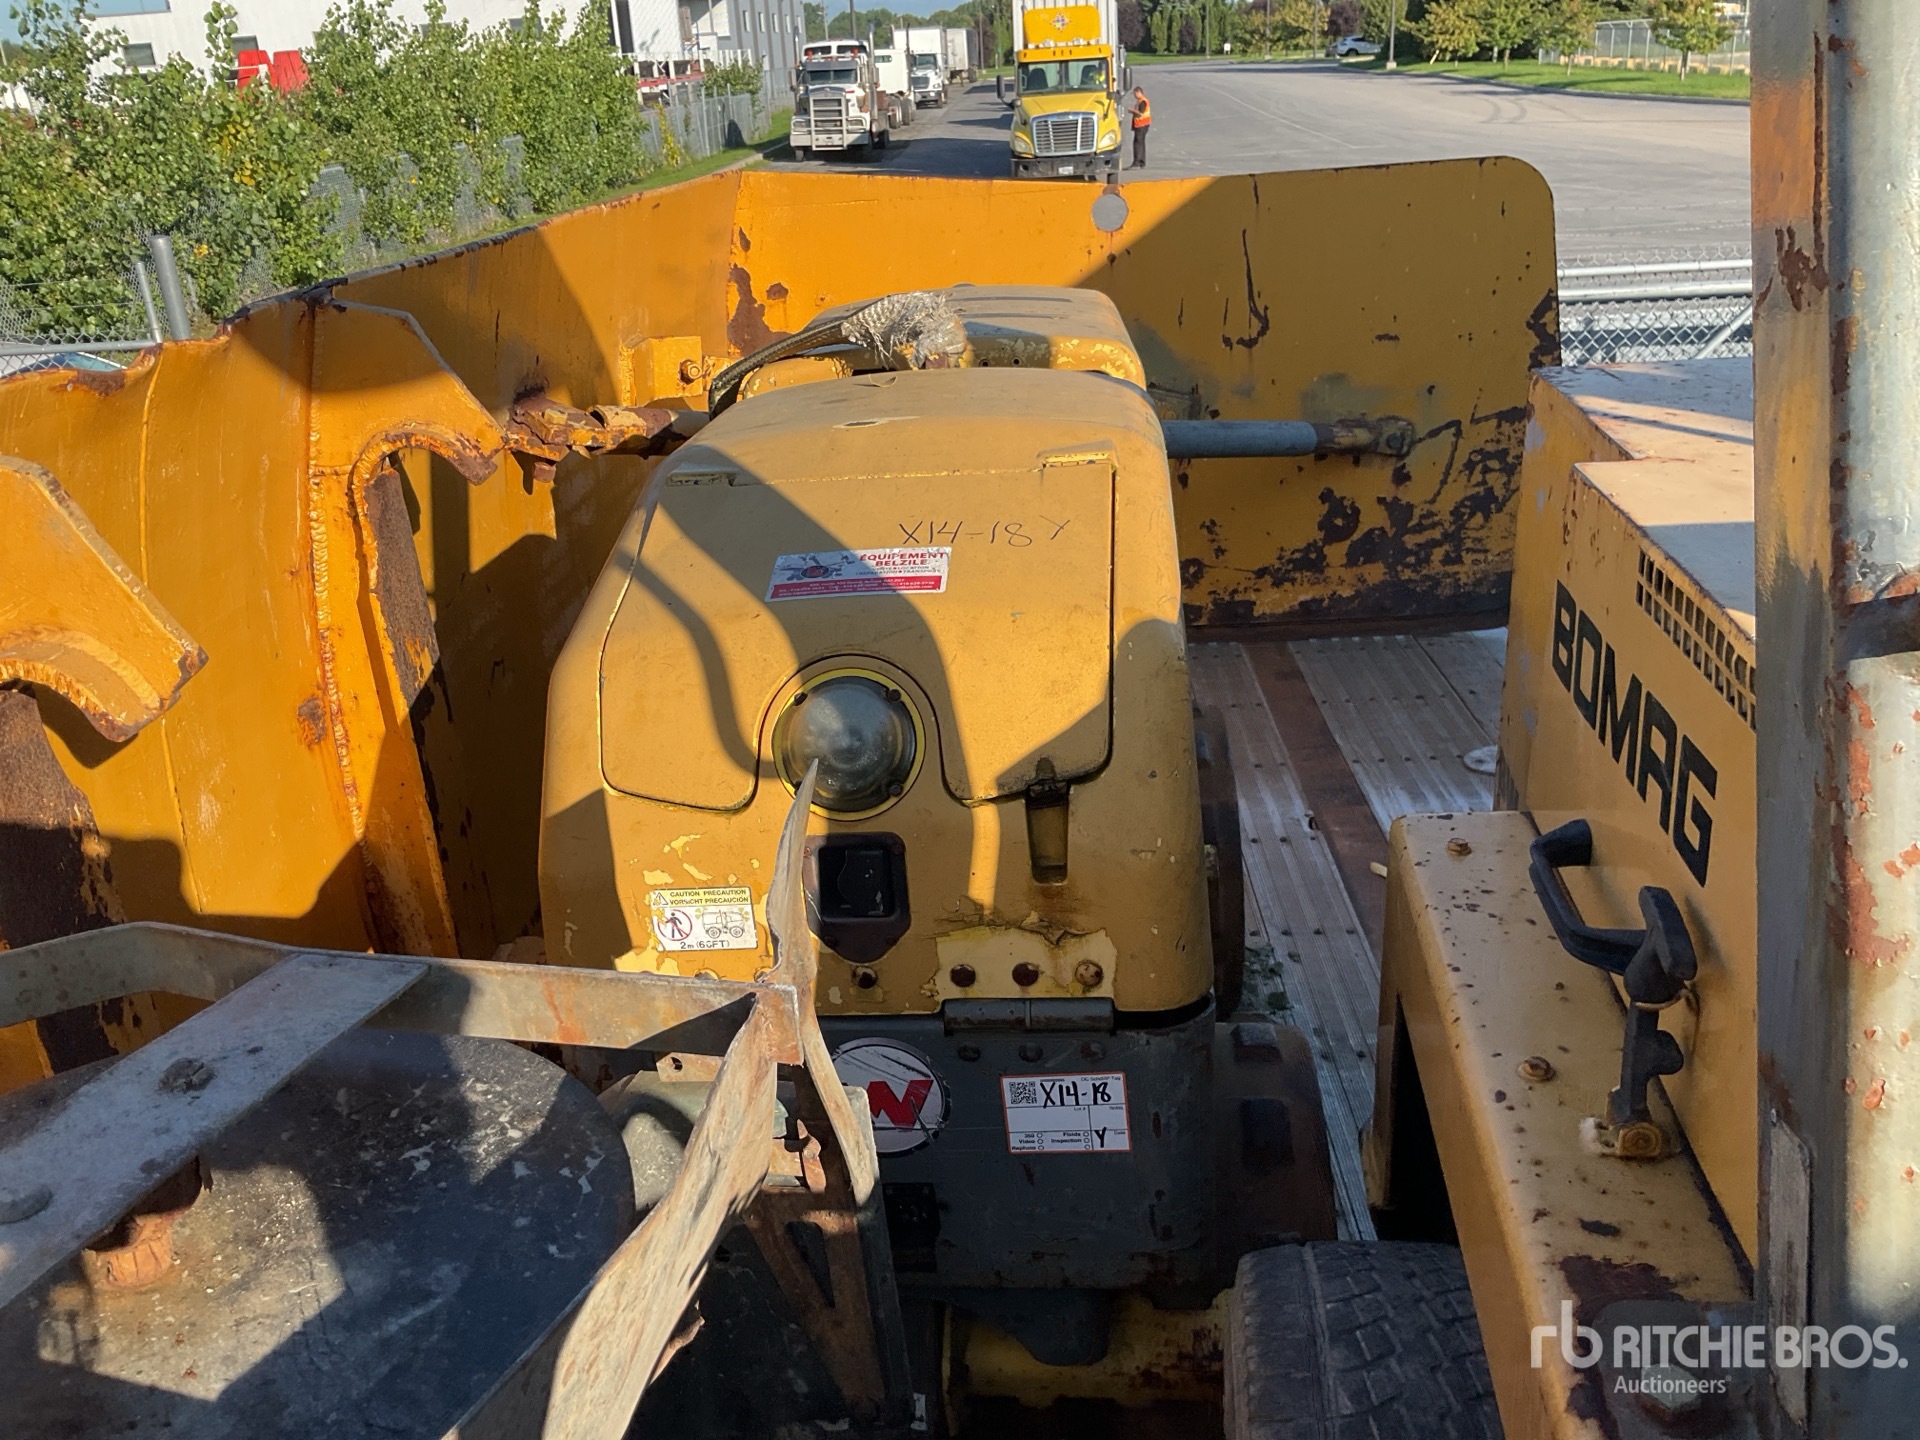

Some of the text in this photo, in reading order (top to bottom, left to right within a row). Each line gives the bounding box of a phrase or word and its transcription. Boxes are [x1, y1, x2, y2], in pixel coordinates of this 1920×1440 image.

[898, 520, 1033, 547] X14-18
[875, 559, 928, 567] BELZILE
[1552, 580, 1718, 887] BOMAG
[1040, 1080, 1112, 1109] X14-18
[1094, 1126, 1107, 1148] Y
